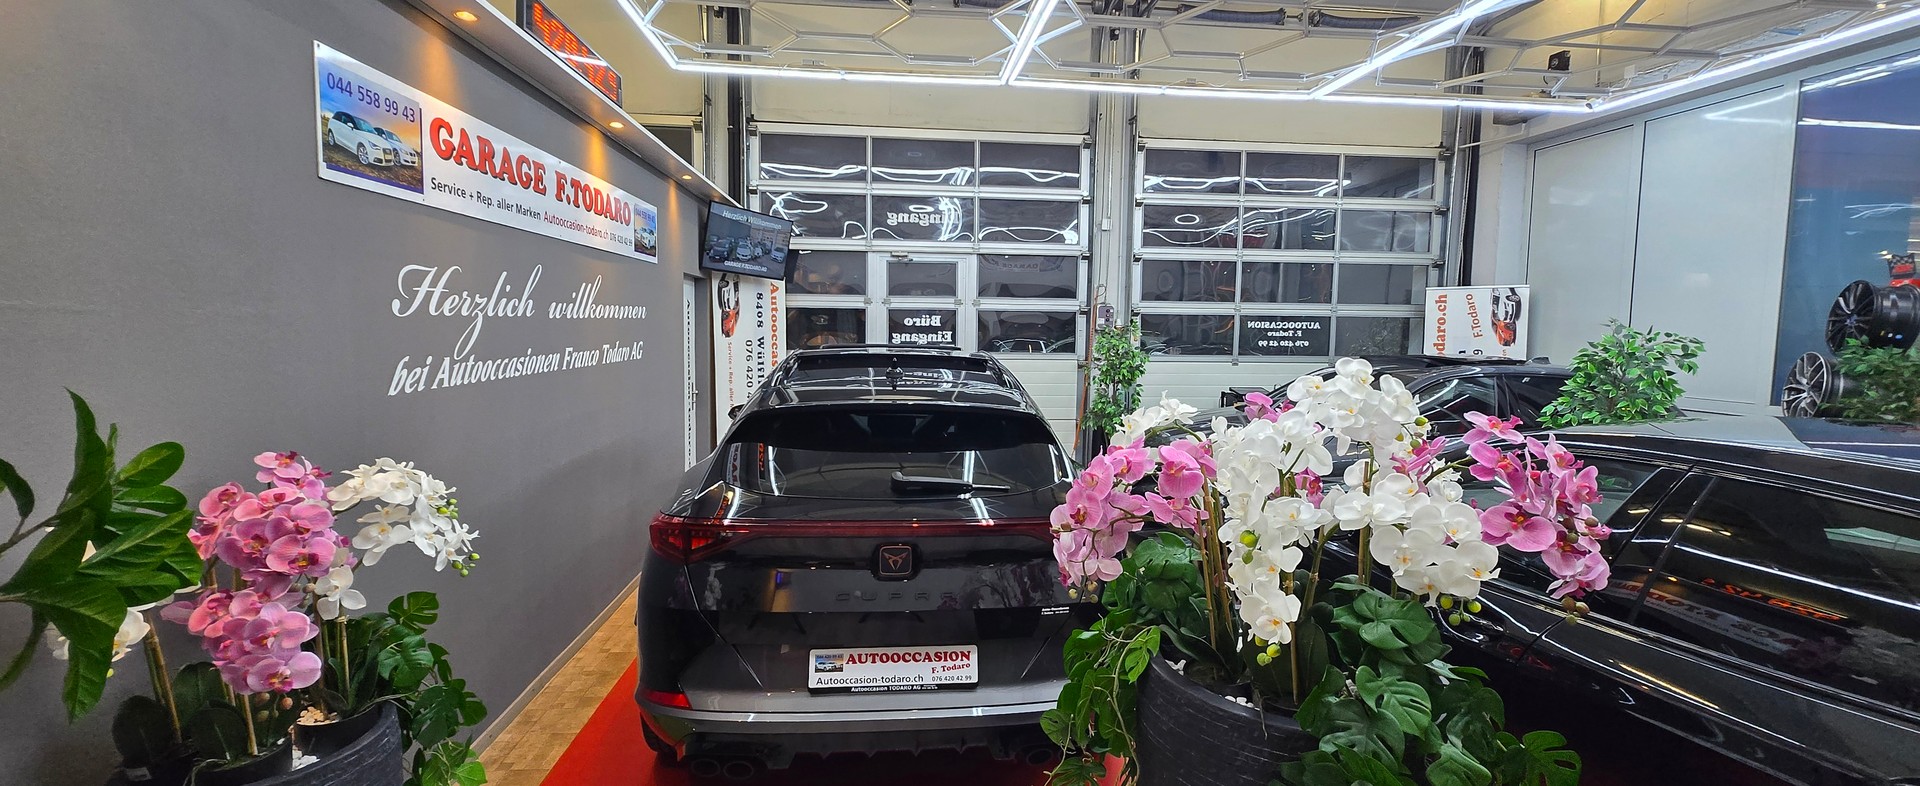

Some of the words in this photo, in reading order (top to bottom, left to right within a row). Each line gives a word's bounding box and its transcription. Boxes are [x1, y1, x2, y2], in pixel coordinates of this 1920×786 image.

[327, 72, 353, 97] 044
[357, 85, 380, 108] 558
[384, 97, 398, 115] 99
[402, 105, 415, 122] 43
[429, 117, 547, 196] GARAGE
[431, 177, 466, 198] Service
[469, 192, 474, 200] +
[476, 191, 494, 208] Rep.
[497, 199, 514, 212] aller
[516, 203, 541, 220] Marken
[543, 211, 609, 240] Autooccasion-todaro.ch
[722, 210, 747, 222] Herzlich
[391, 264, 542, 360] Herzlich
[548, 274, 647, 320] willkommen
[756, 292, 764, 328] 8408
[770, 281, 779, 369] Autooccas
[388, 355, 433, 396] bei
[431, 348, 560, 390] Autooccasionen
[562, 347, 599, 370] Franco
[601, 342, 631, 365] Todaro
[630, 341, 644, 361] AG
[745, 339, 753, 362] 076
[745, 365, 753, 388] 420
[845, 651, 971, 664] AUTOOCCASION
[941, 663, 971, 672] Todaro
[816, 674, 923, 686] Autooccasion-todaro.ch
